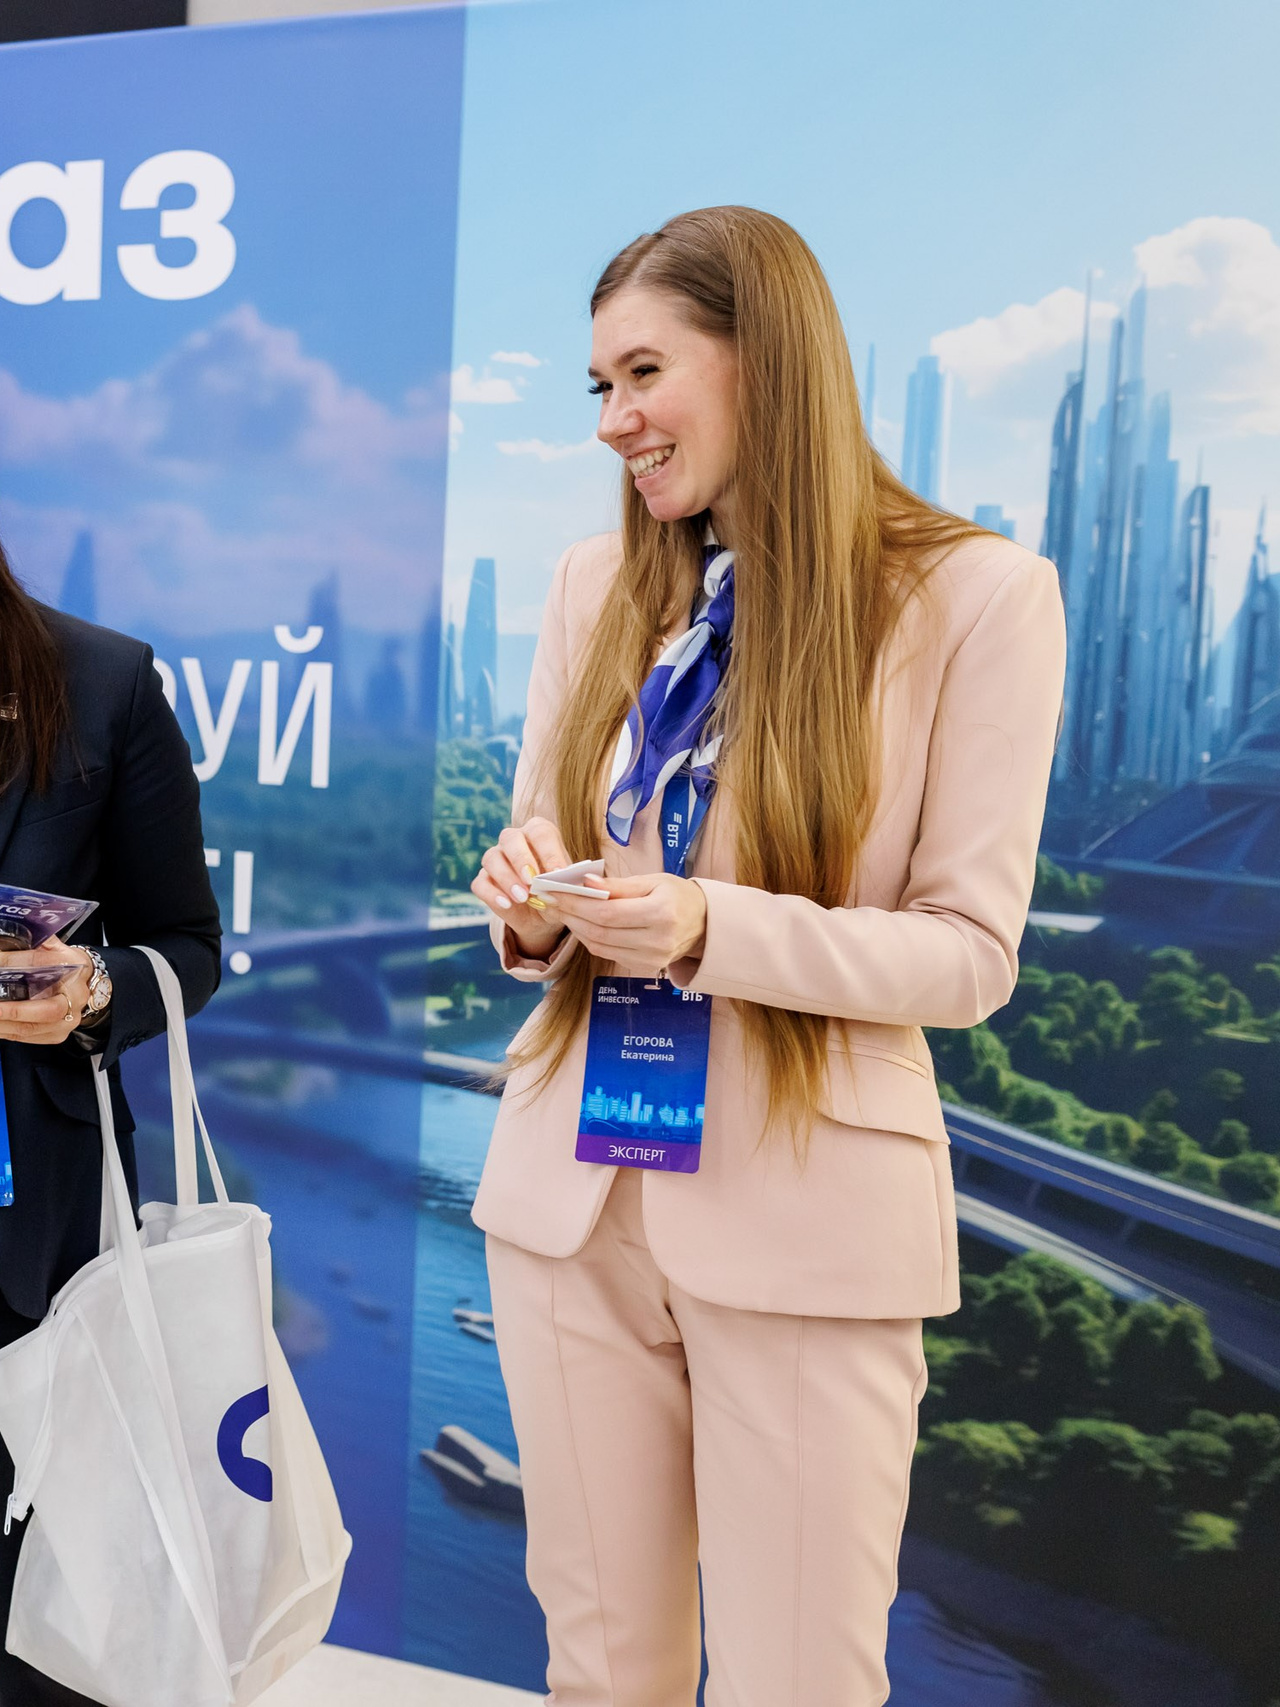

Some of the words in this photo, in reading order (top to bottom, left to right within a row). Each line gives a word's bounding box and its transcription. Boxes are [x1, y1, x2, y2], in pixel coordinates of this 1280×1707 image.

[667, 823, 679, 848] ВТБ
[598, 986, 618, 995] ДЕНЬ
[682, 990, 703, 1002] ВТБ
[598, 996, 640, 1005] ИНВЕСТОРА
[623, 1035, 674, 1048] ЕГОРОВА
[621, 1049, 675, 1063] Екатерина
[608, 1145, 666, 1163] ЭКСПЕРТ
